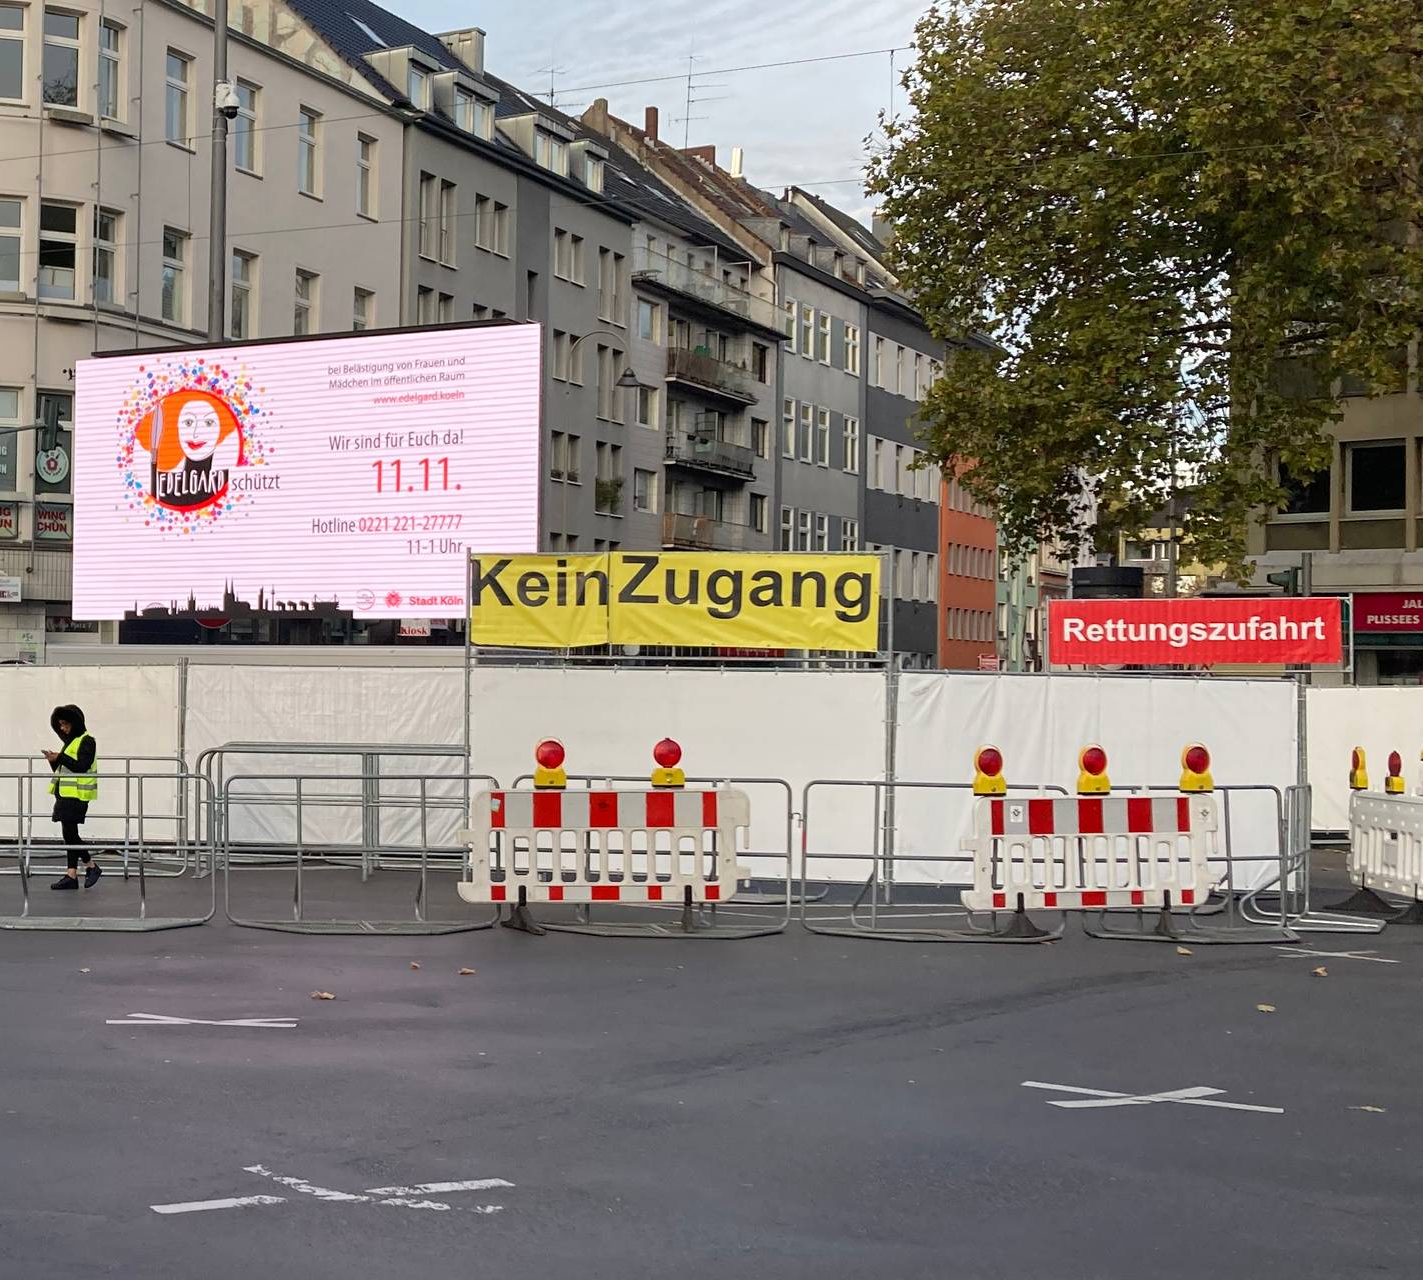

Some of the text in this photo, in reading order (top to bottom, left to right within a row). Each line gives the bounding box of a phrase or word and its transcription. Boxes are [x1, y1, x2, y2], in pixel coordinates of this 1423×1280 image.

[328, 357, 465, 375] bei Belästigung von Frauen und
[329, 372, 465, 389] Mädchen im öffentlichen Raum
[373, 390, 465, 404] www.edelgard.koeln
[329, 428, 464, 450] Wir sind für Euch da!
[372, 457, 461, 493] 11.11.
[159, 470, 280, 498] EDELGARD schützt
[38, 510, 66, 521] WING
[312, 514, 463, 533] Hotline 0221 221-27777
[37, 522, 67, 532] CHUN
[408, 538, 462, 554] 11-1 Uhr
[471, 555, 873, 623] Kein Zugang
[409, 595, 463, 606] Stadt Köln
[1367, 615, 1420, 624] PLISSEES
[401, 626, 427, 635] Kiosk
[1063, 616, 1326, 646] Rettungszufahrt
